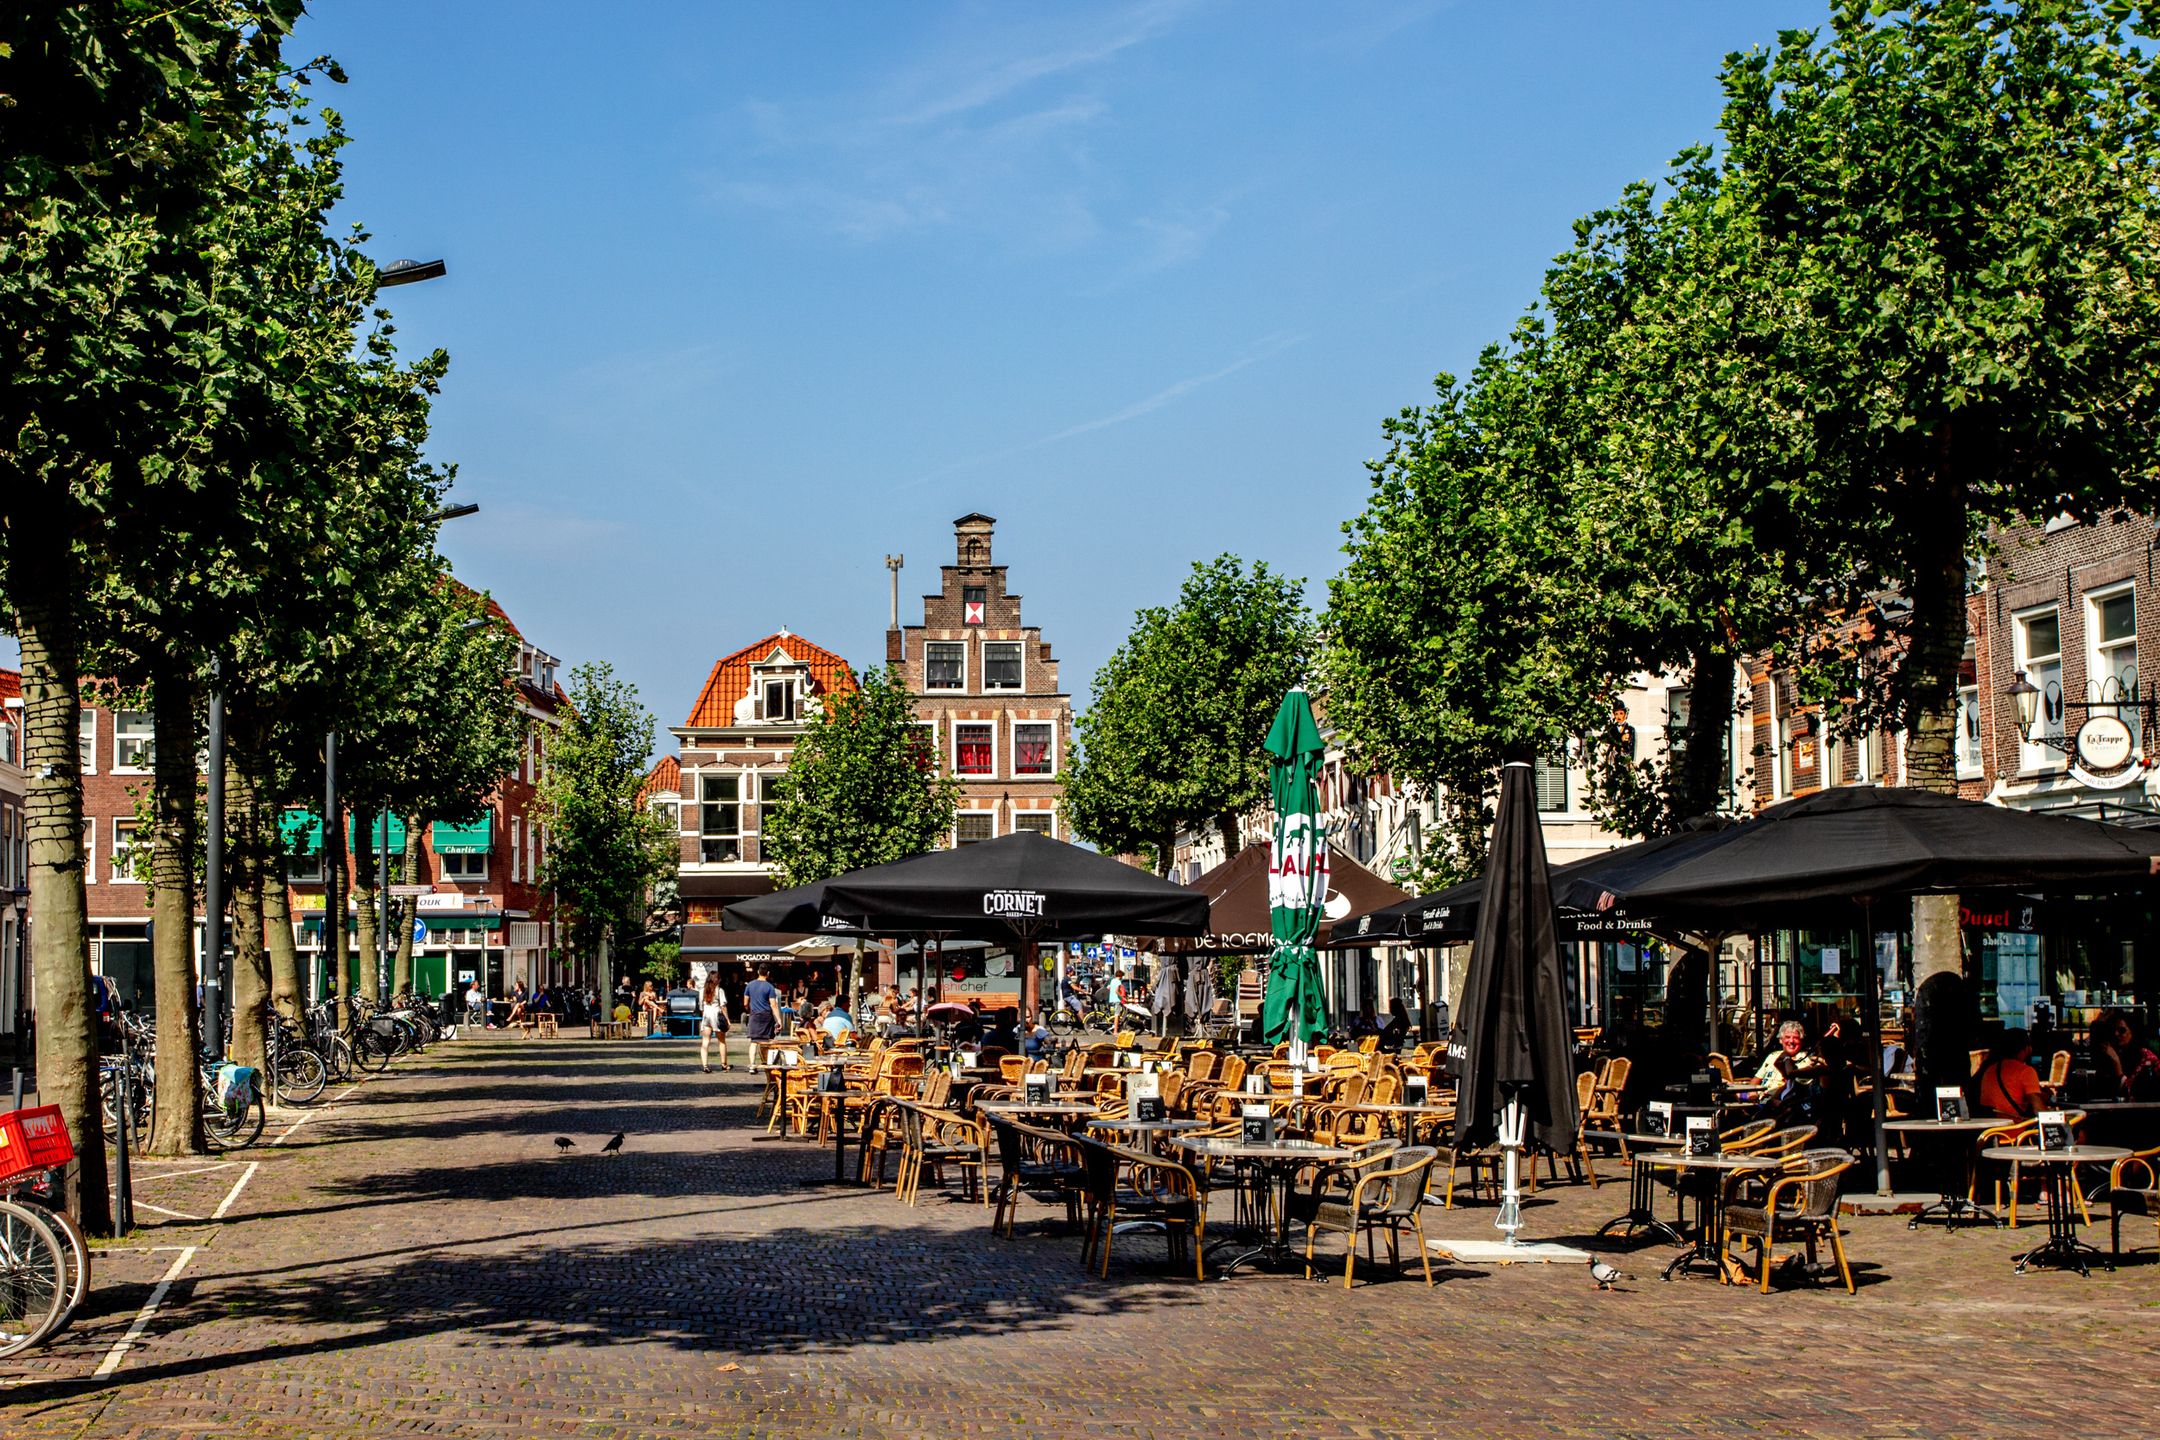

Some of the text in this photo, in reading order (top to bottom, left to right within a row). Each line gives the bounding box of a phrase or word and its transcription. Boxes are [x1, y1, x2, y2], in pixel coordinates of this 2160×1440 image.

[2096, 734, 2124, 745] Trappe
[445, 846, 477, 854] Charlie
[983, 893, 1046, 916] CORNET
[1576, 919, 1653, 931] Food & Drinks
[1194, 932, 1276, 949] DE ROEME
[736, 953, 771, 961] MOGADOR
[928, 981, 989, 992] shichef
